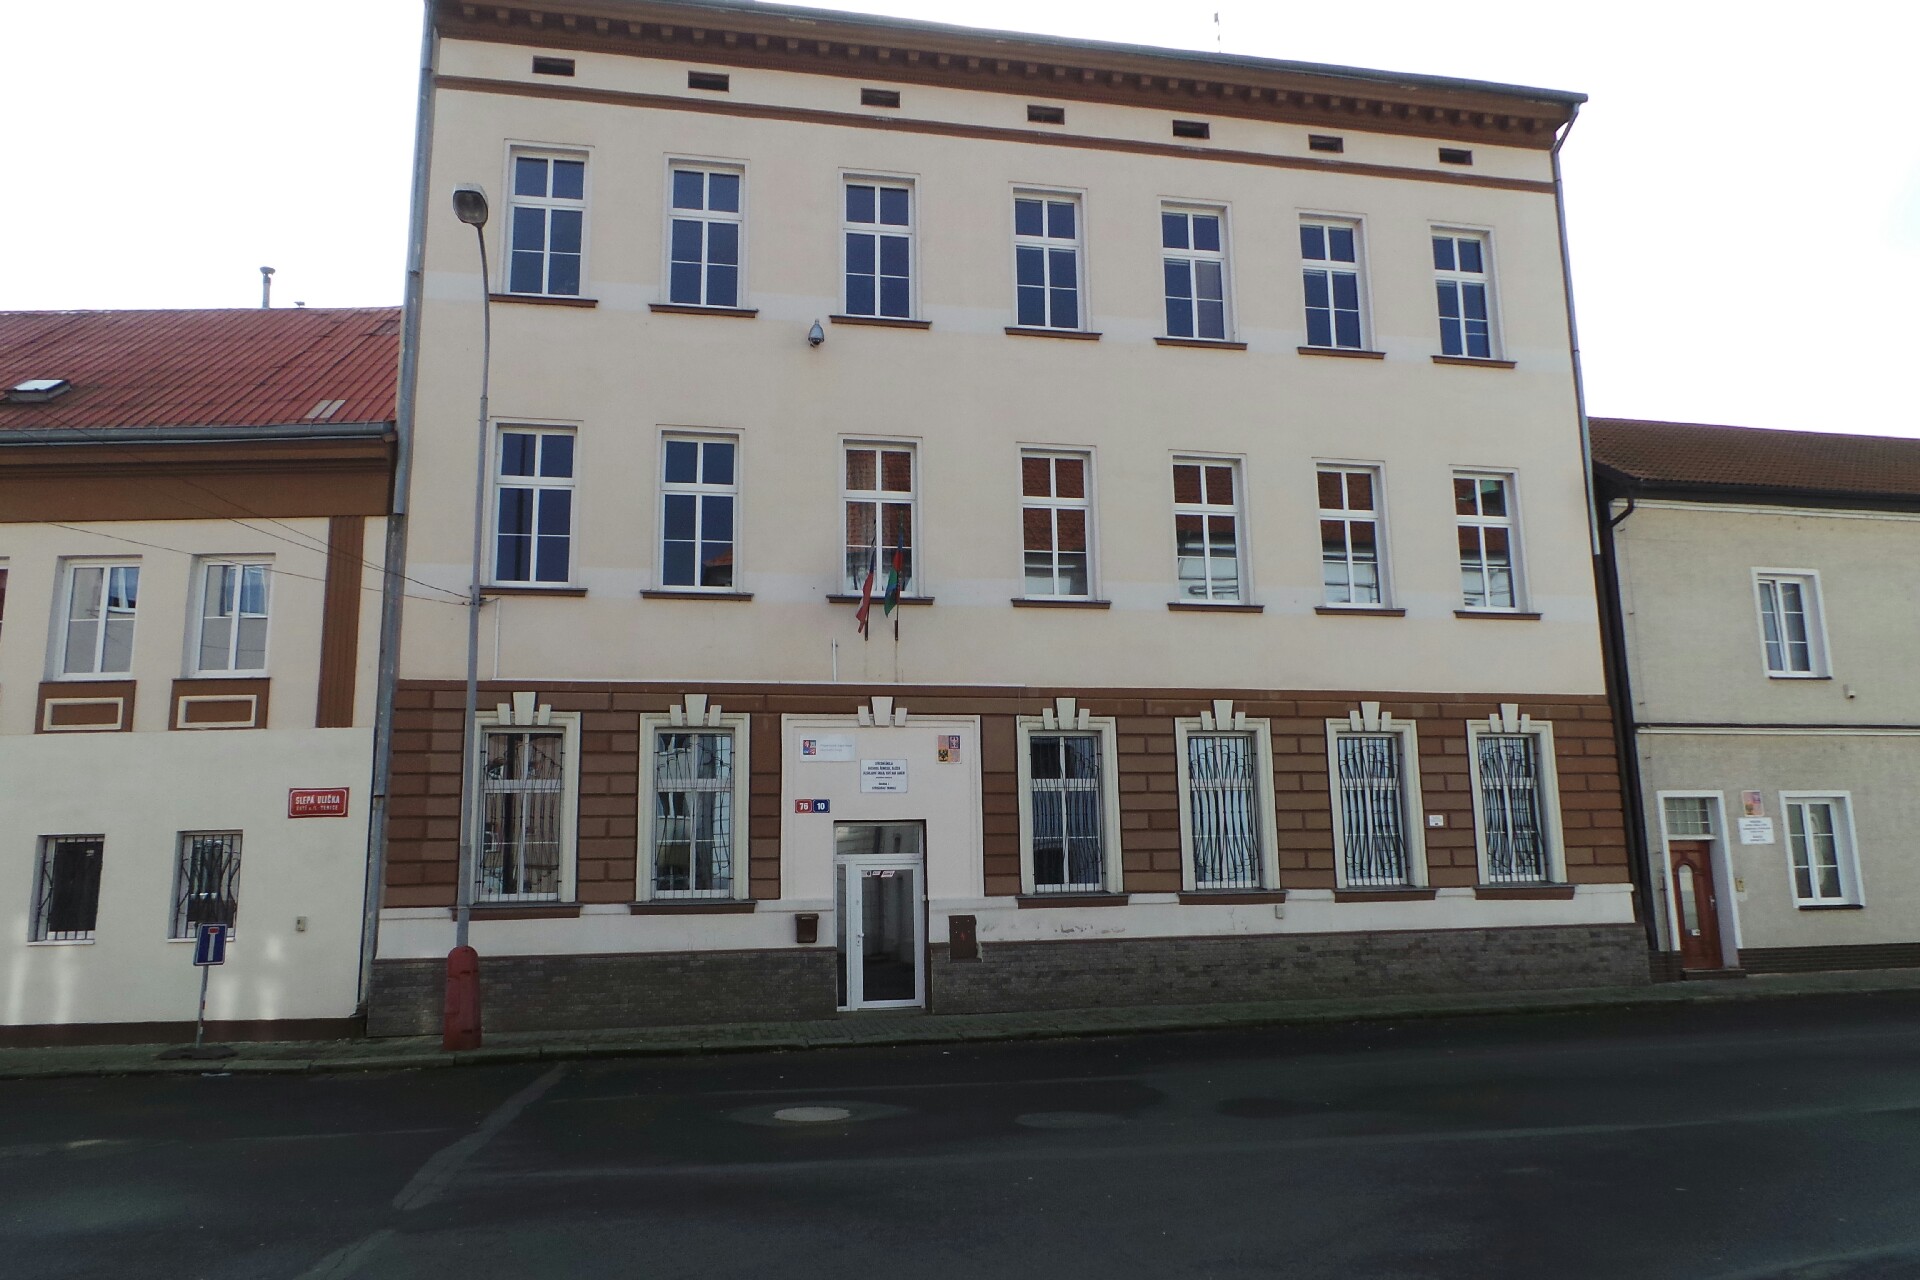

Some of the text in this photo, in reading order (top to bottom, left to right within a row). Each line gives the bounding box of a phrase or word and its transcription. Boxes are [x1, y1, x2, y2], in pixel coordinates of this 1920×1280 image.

[295, 794, 340, 805] SLEPÁ ULIČKA
[816, 802, 826, 811] 10
